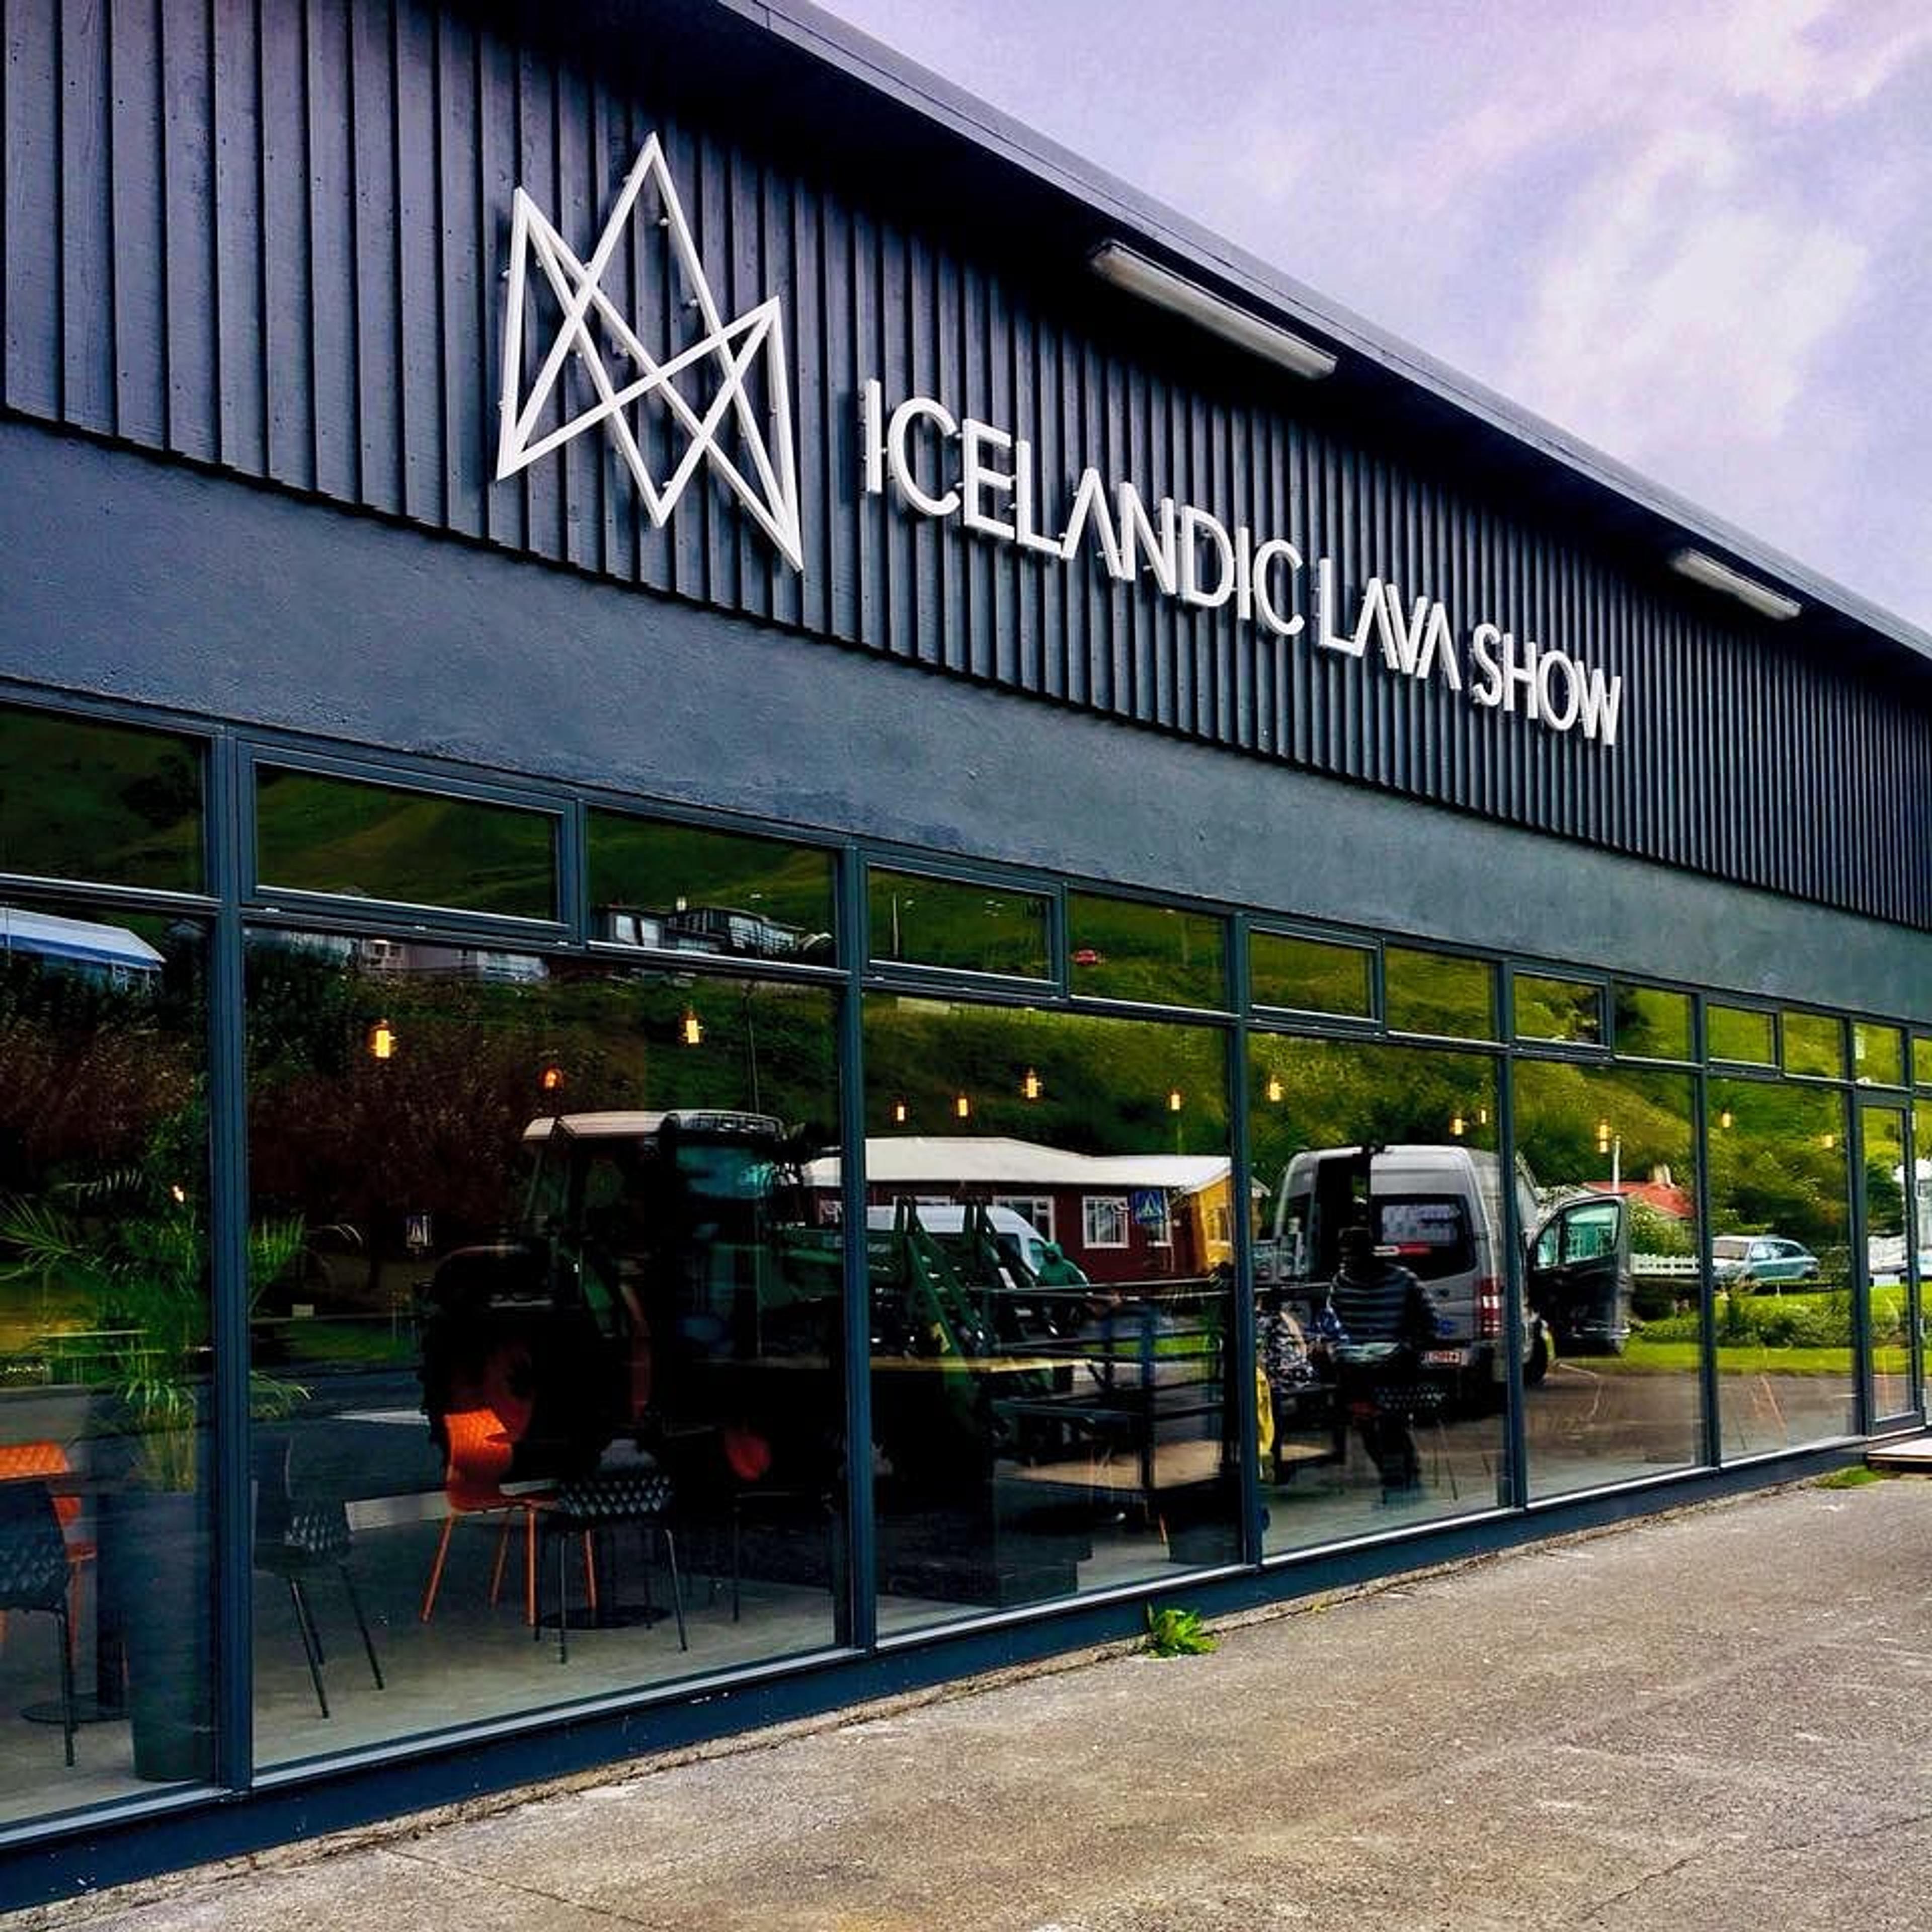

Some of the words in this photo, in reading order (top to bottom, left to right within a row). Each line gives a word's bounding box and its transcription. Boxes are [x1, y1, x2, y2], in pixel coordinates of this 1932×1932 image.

[861, 378, 1304, 636] ICELANDIC
[1317, 557, 1461, 691] LAVA
[1471, 623, 1621, 746] SHOW
